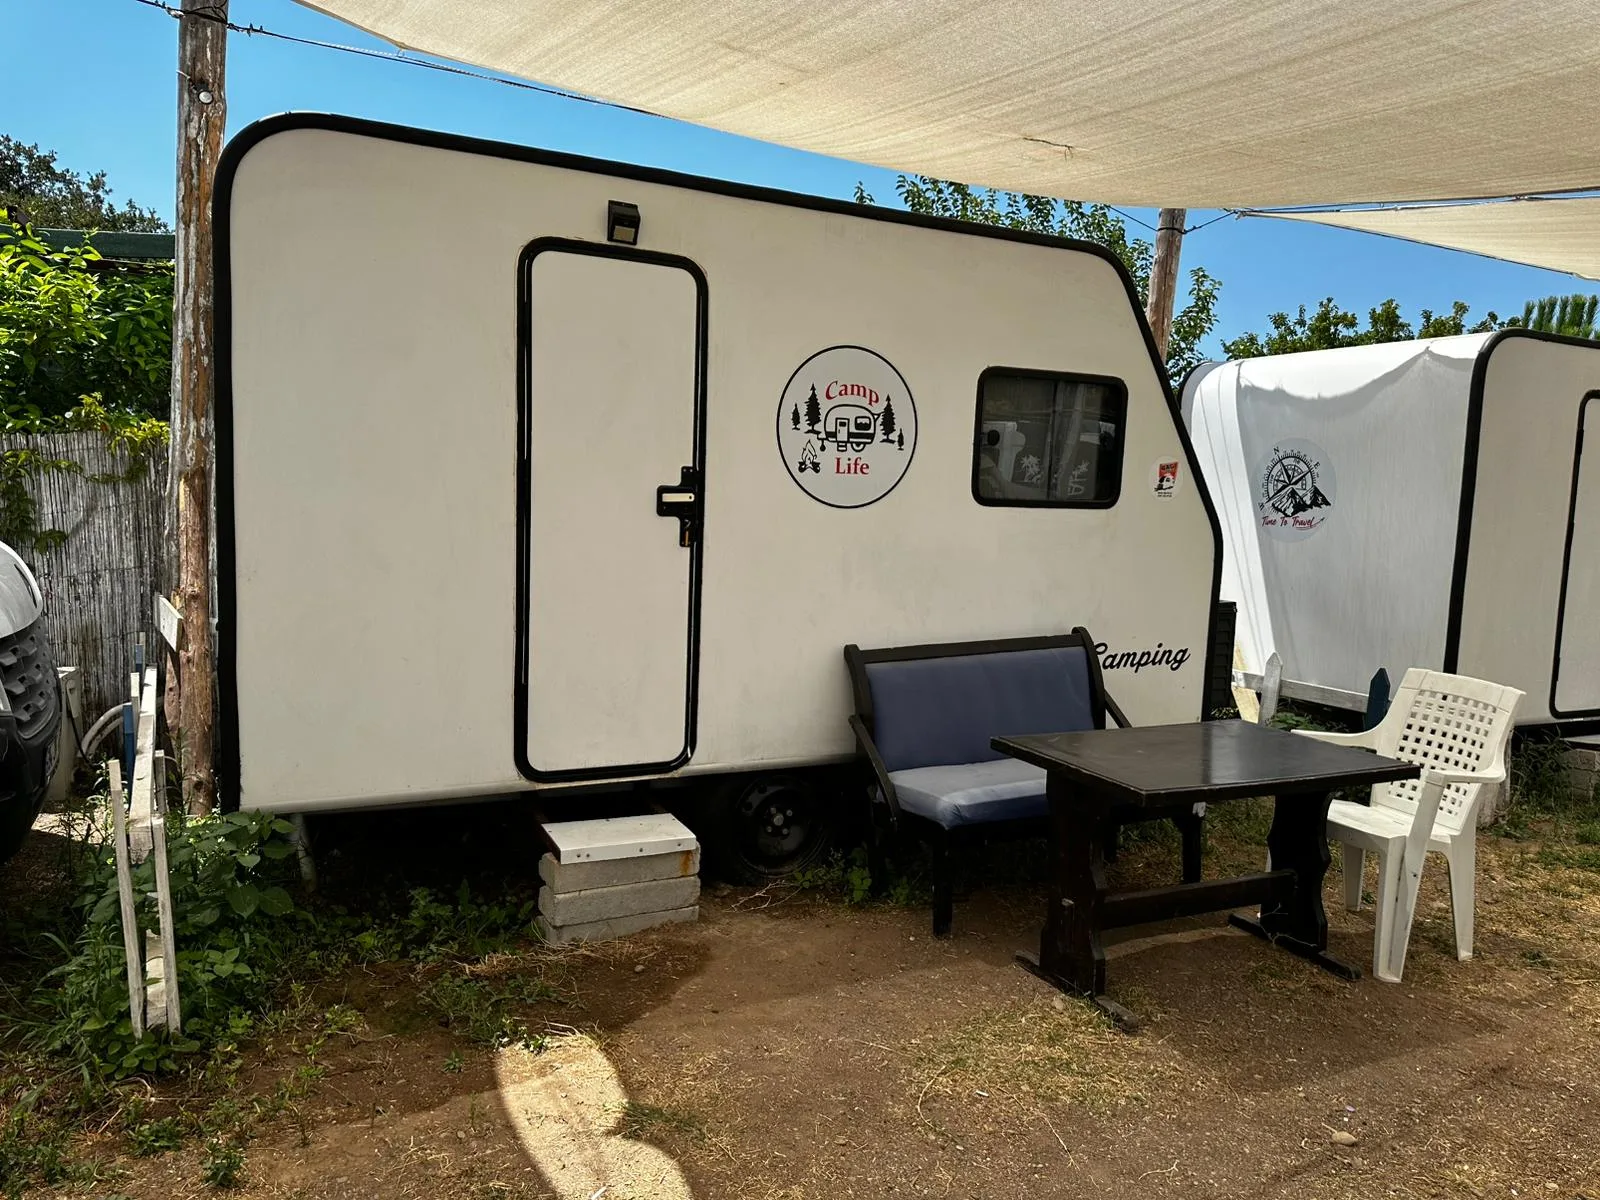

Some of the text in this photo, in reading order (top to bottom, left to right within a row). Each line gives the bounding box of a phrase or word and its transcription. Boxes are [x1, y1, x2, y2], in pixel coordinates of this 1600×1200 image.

[825, 380, 880, 407] Camp
[835, 457, 870, 475] Life
[1261, 516, 1314, 528] Time To Travel
